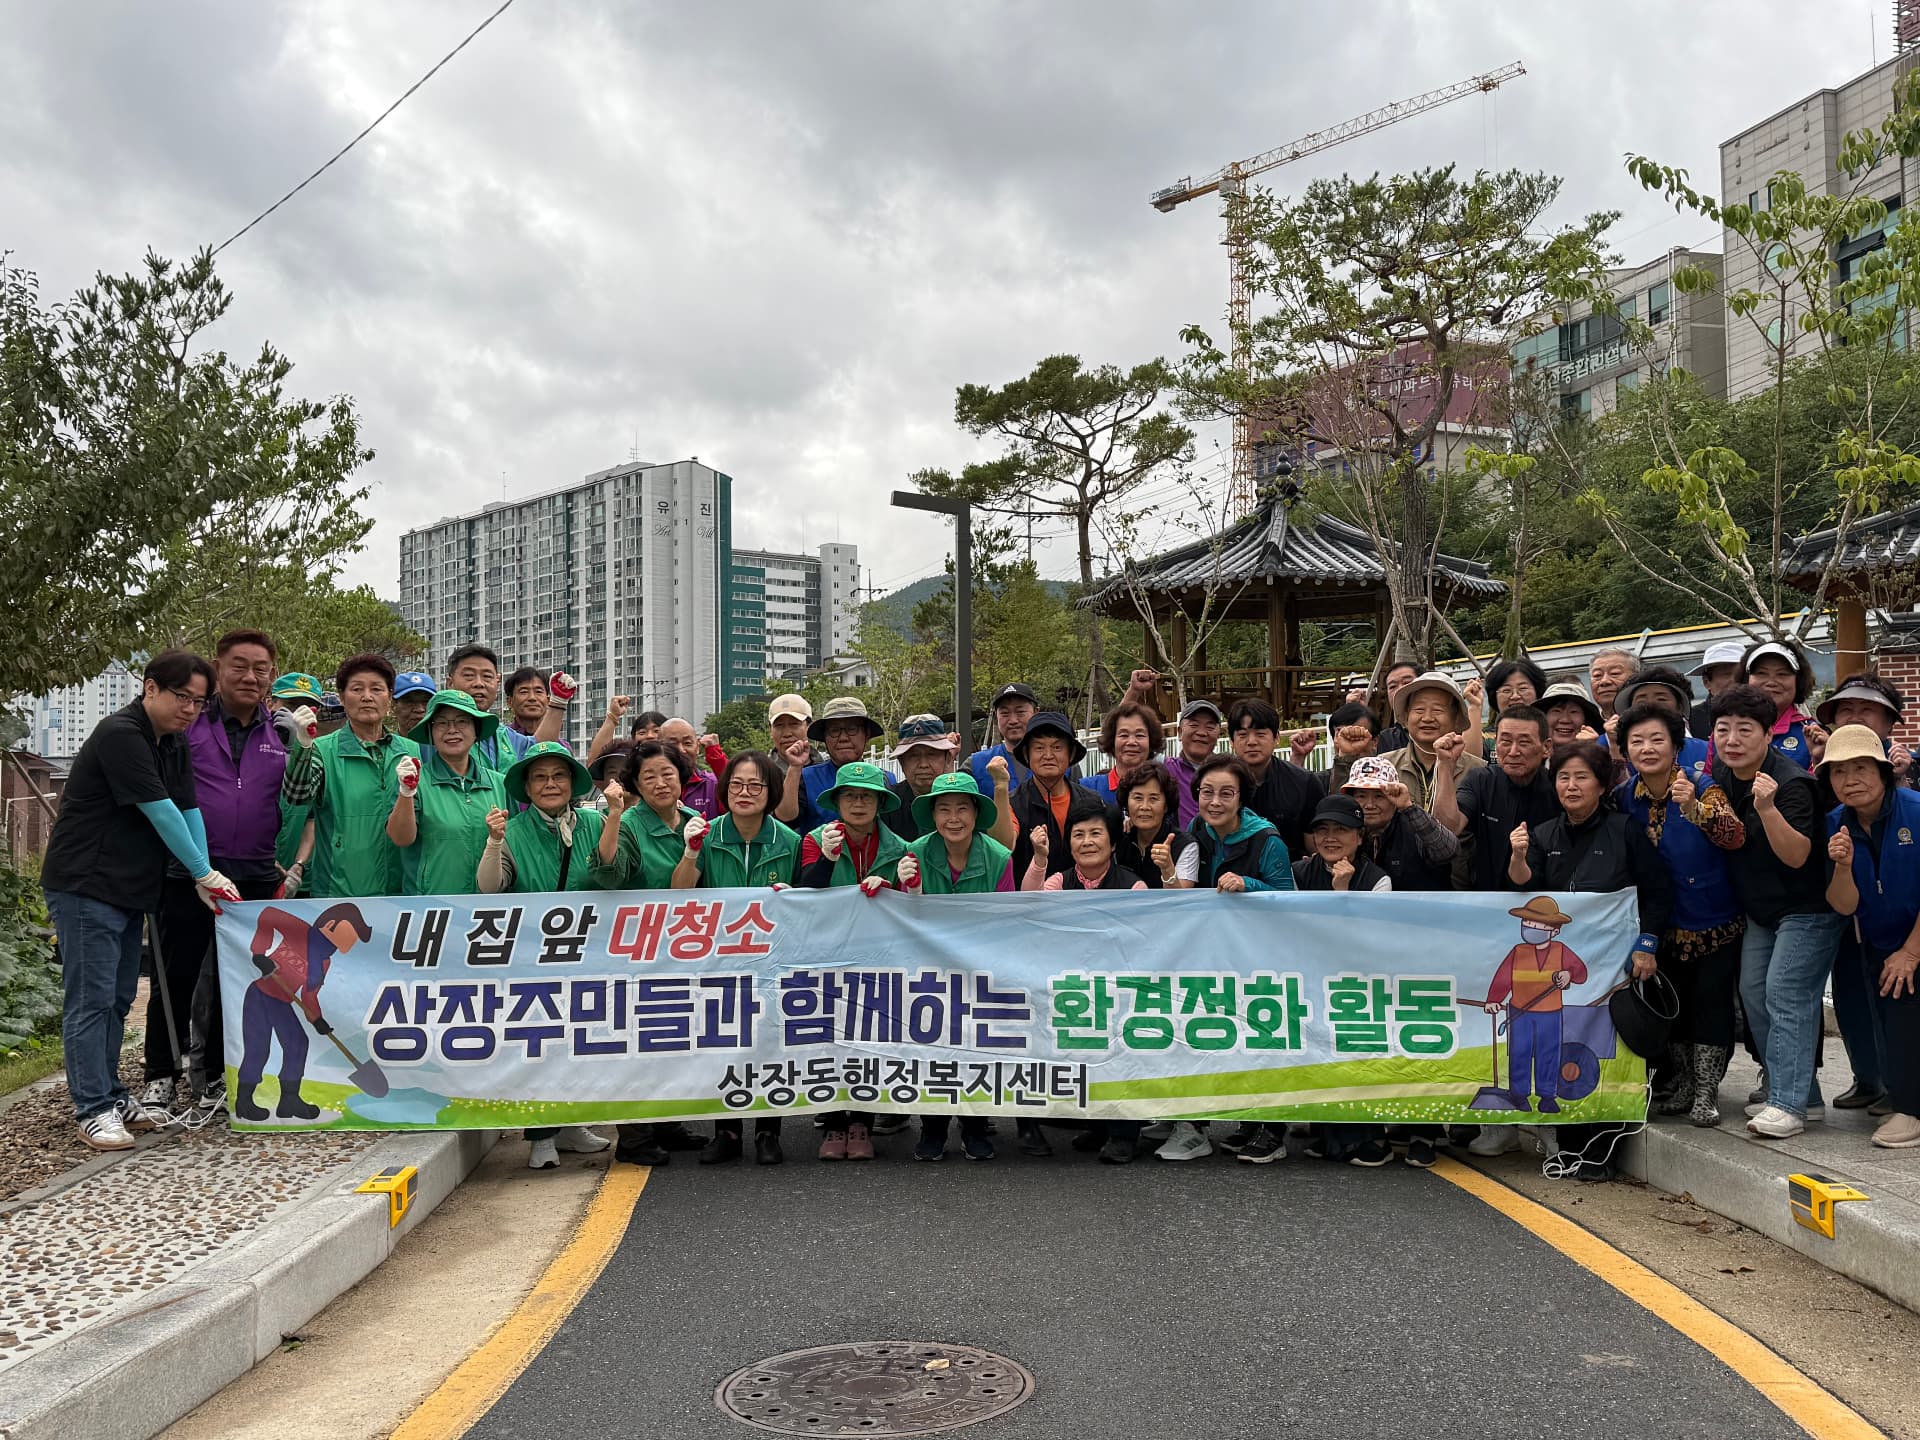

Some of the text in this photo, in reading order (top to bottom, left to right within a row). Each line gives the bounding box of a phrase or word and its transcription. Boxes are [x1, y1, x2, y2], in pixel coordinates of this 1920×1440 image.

[657, 501, 711, 516] 유 진
[391, 901, 775, 968] 내 집 앞 대청소
[367, 970, 1457, 1062] 상장주민들과 함께하는 환경정화 활동
[717, 1057, 1087, 1108] 상장동행정복지센터
